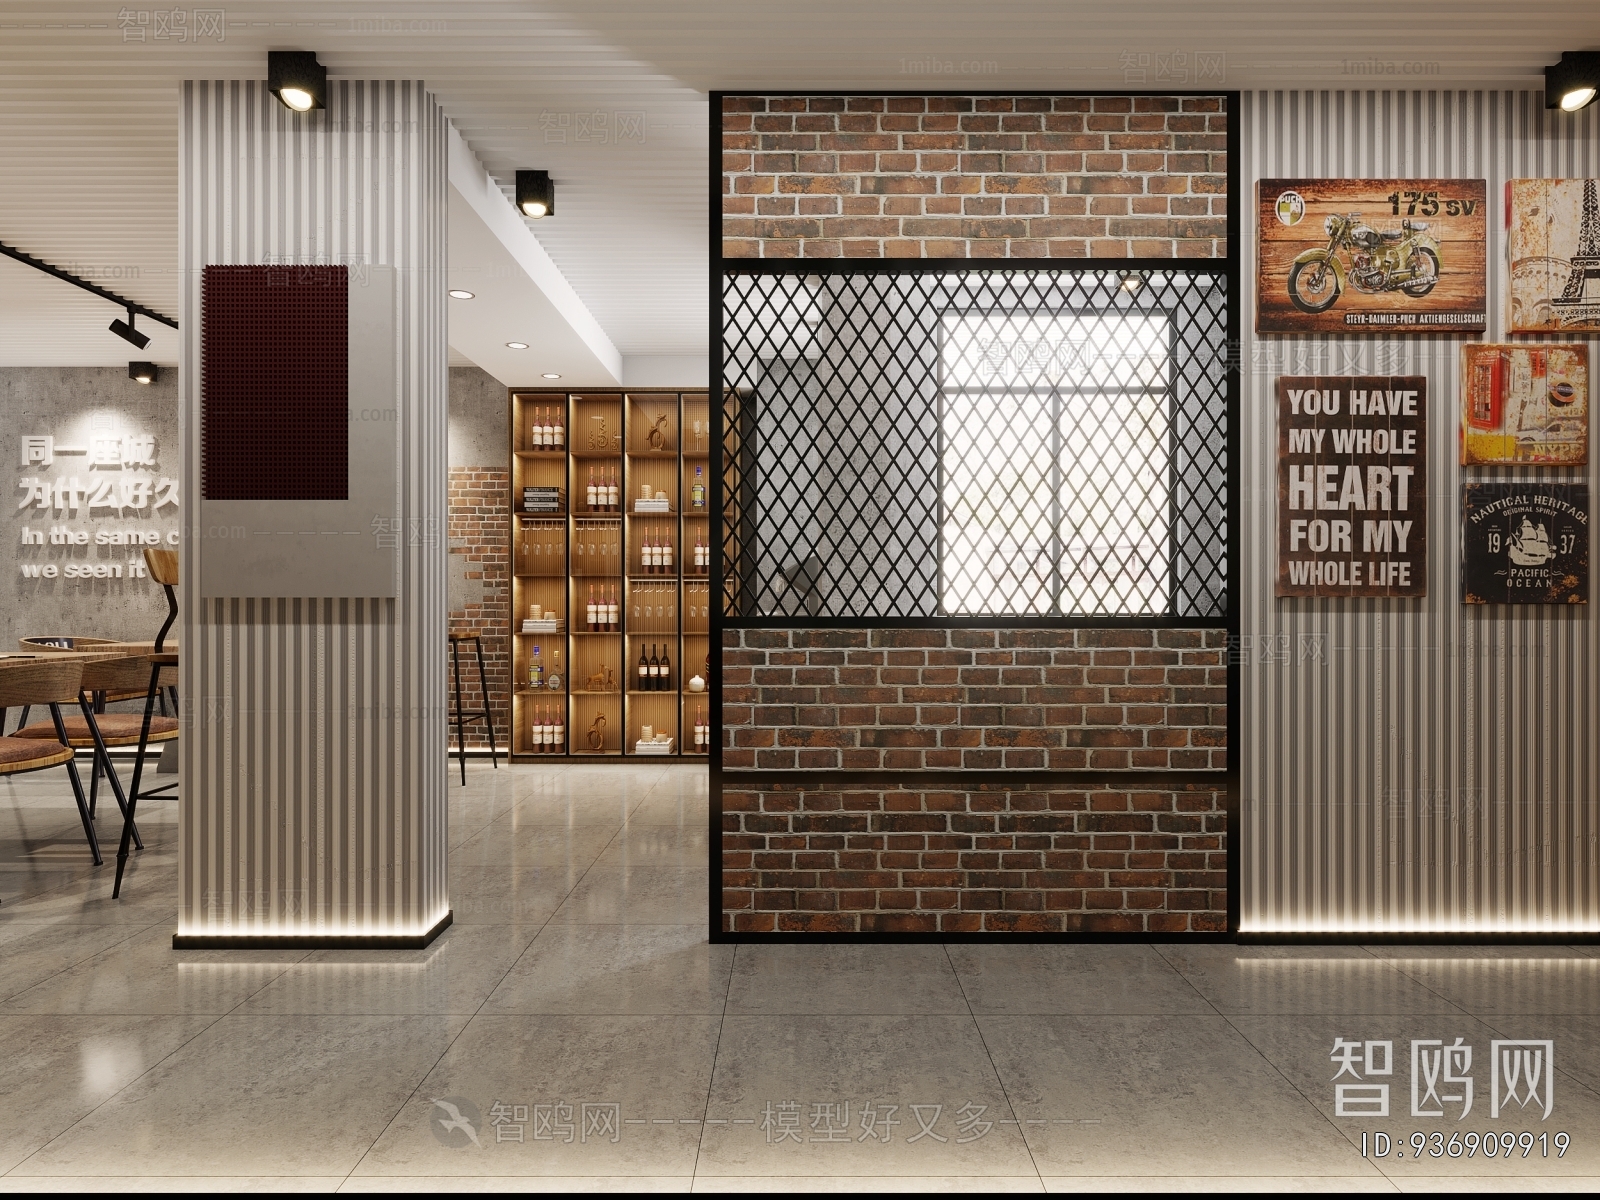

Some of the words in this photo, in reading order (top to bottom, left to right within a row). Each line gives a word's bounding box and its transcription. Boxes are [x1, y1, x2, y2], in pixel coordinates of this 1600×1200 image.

[1279, 194, 1302, 204] PUCH
[1388, 191, 1440, 217] 175
[1287, 389, 1340, 415] YOU
[1350, 390, 1418, 416] HAVE
[21, 434, 156, 467] 同一座城
[1288, 428, 1326, 454] MY
[1331, 428, 1417, 454] WHOLE
[18, 477, 180, 510] 为什么好久
[1288, 464, 1415, 511] HEART
[1470, 495, 1529, 524] NAUTICAL
[1534, 495, 1588, 525] HERITAGE
[1502, 506, 1534, 517] ORIGINAL
[1535, 506, 1558, 517] SPIRIT
[21, 526, 43, 546] In
[49, 525, 89, 546] the
[95, 529, 161, 546] same
[1290, 519, 1352, 552] FOR
[1363, 520, 1413, 552] MY
[1487, 532, 1501, 554] 19
[1560, 534, 1576, 555] 37
[20, 563, 58, 578] we
[63, 563, 122, 578] seen
[128, 559, 146, 578] it
[1288, 560, 1362, 586] WHOLE
[1369, 561, 1411, 587] LIFE
[1510, 568, 1550, 578] PACIFIC
[1506, 579, 1553, 588] OCEAN
